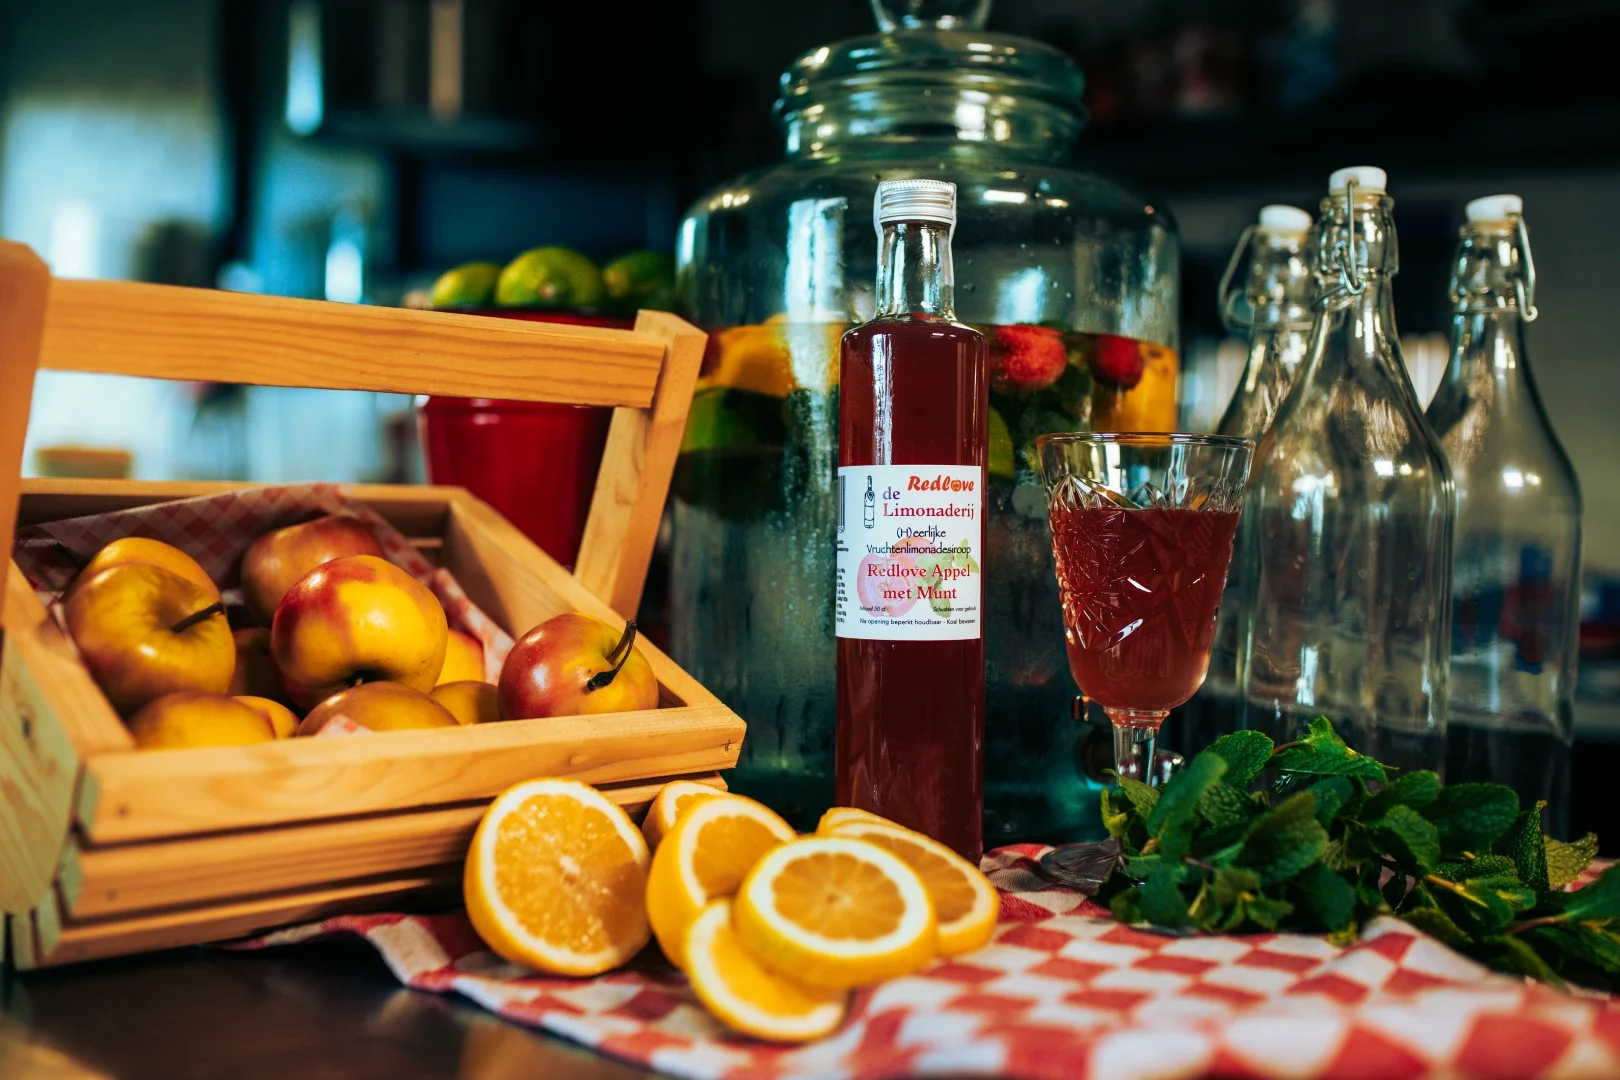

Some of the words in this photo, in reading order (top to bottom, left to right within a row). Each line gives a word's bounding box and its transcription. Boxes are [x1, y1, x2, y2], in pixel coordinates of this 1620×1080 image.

[907, 474, 974, 492] Redlove
[882, 486, 901, 500] de
[882, 502, 974, 520] Limonaderij
[896, 525, 946, 544] (H)eerlijke
[866, 542, 972, 559] Vruchtenlimonadesiroop
[867, 563, 927, 577] Redlove
[931, 563, 971, 580] Appel
[883, 588, 912, 599] met
[917, 586, 957, 599] Munt
[867, 618, 890, 626] opening
[890, 618, 913, 626] beperkt
